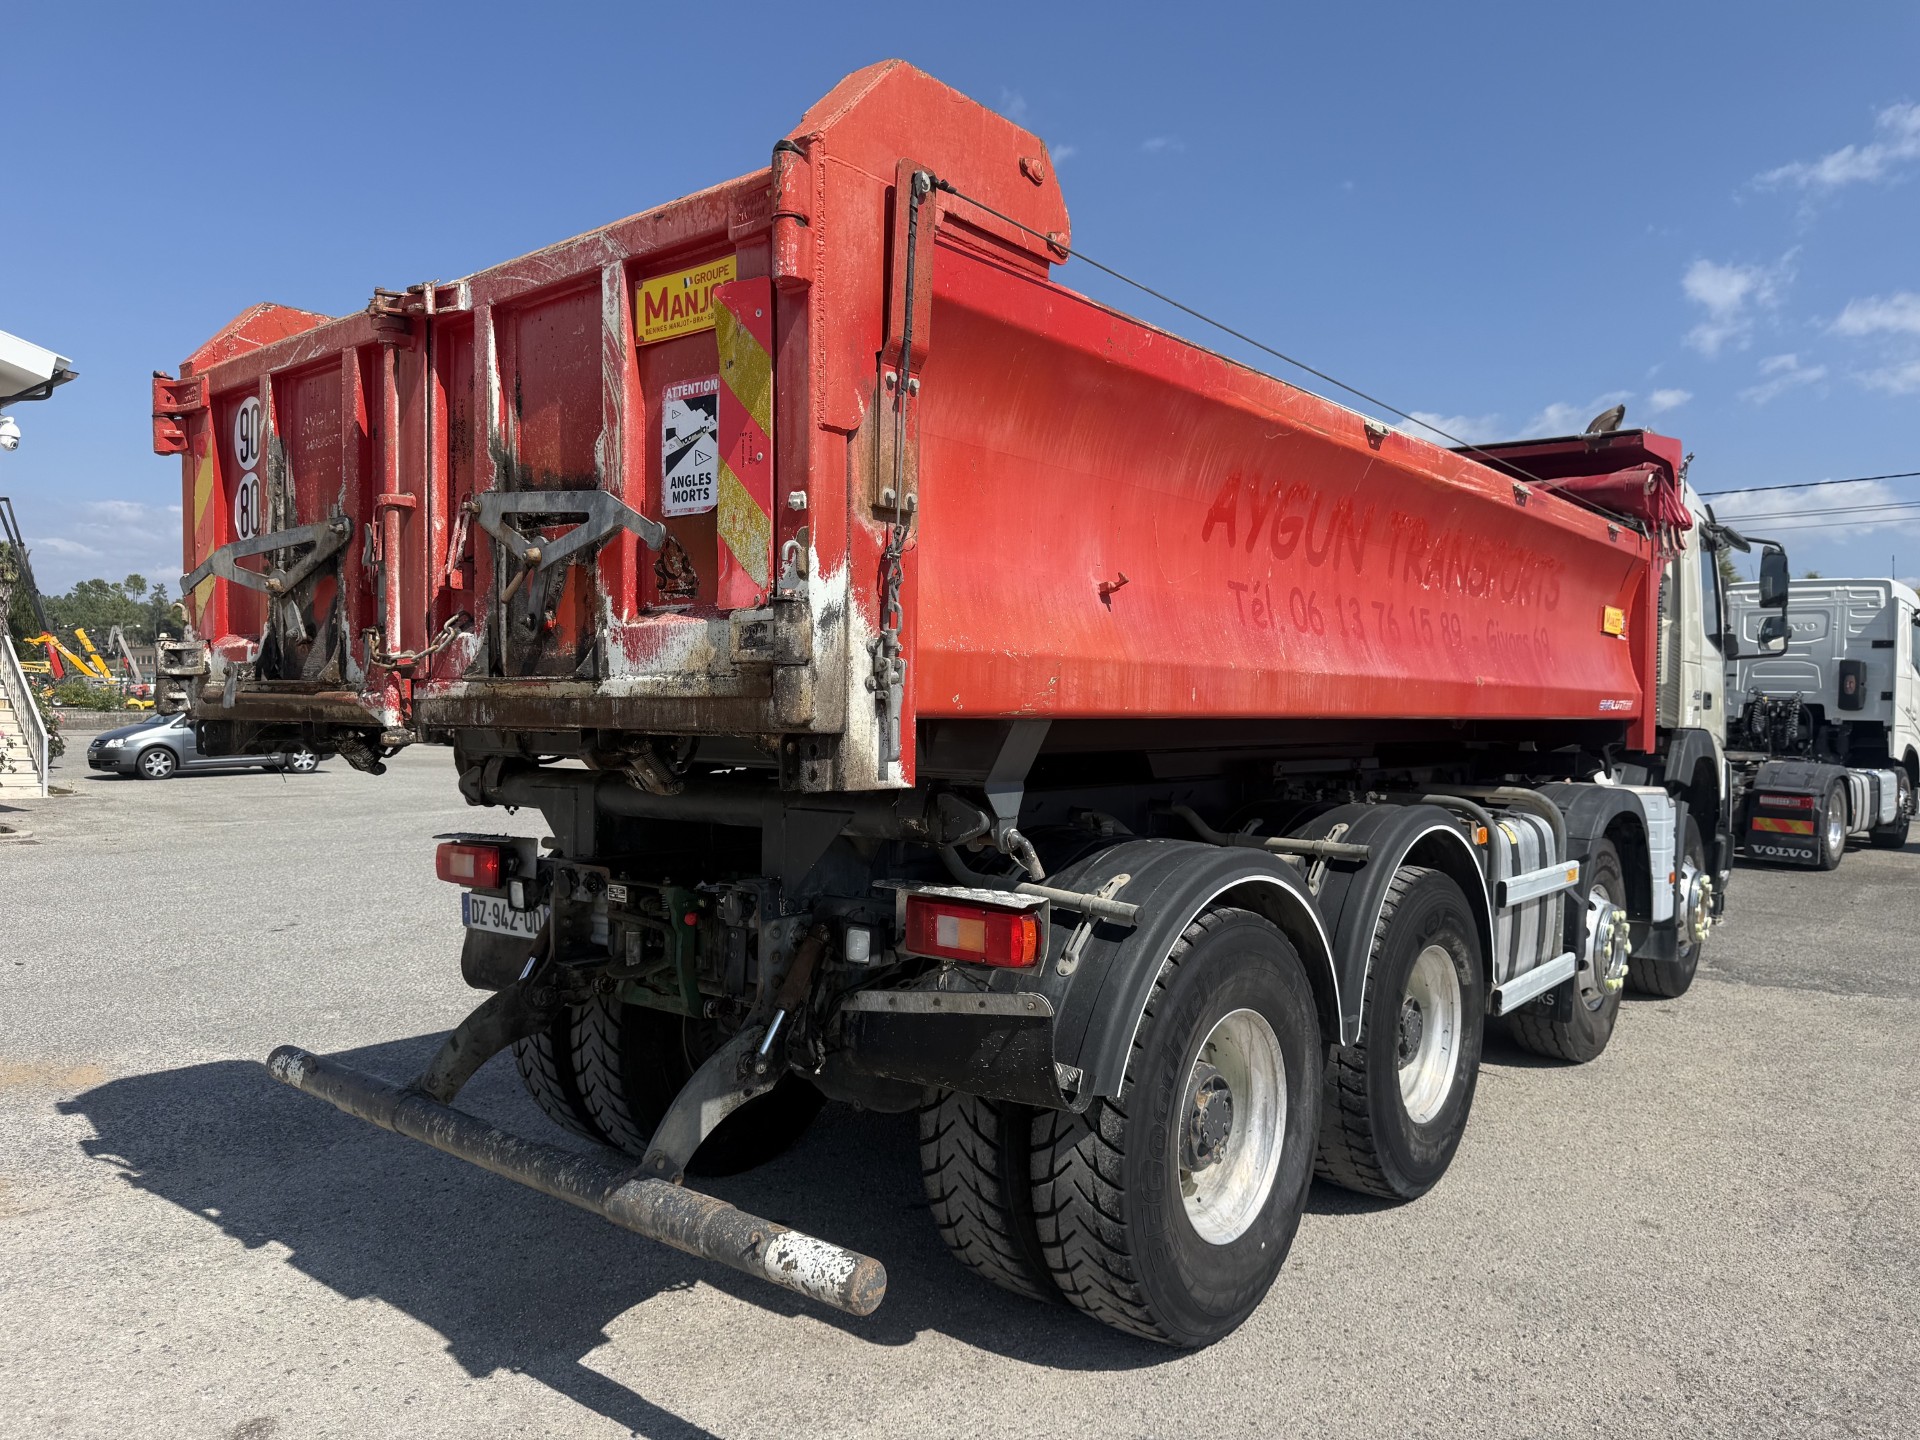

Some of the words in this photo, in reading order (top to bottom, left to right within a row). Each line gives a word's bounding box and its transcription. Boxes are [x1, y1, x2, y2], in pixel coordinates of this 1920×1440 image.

[694, 264, 730, 285] GROUPE
[645, 324, 669, 336] BENNES
[666, 379, 718, 400] ATTENTION
[240, 403, 261, 463] 90
[670, 472, 712, 489] ANGLES
[672, 487, 710, 504] MORTS
[240, 479, 261, 538] 80
[1202, 470, 1375, 575] AYGUN
[1387, 511, 1566, 612] TRANSPORTS
[1227, 580, 1286, 633] Tél.
[1289, 586, 1325, 637] 06
[1334, 593, 1367, 642] 13
[1371, 600, 1400, 646] 76
[1409, 605, 1434, 646] 15
[1440, 611, 1462, 648] 89
[1750, 844, 1813, 859] VOLVO
